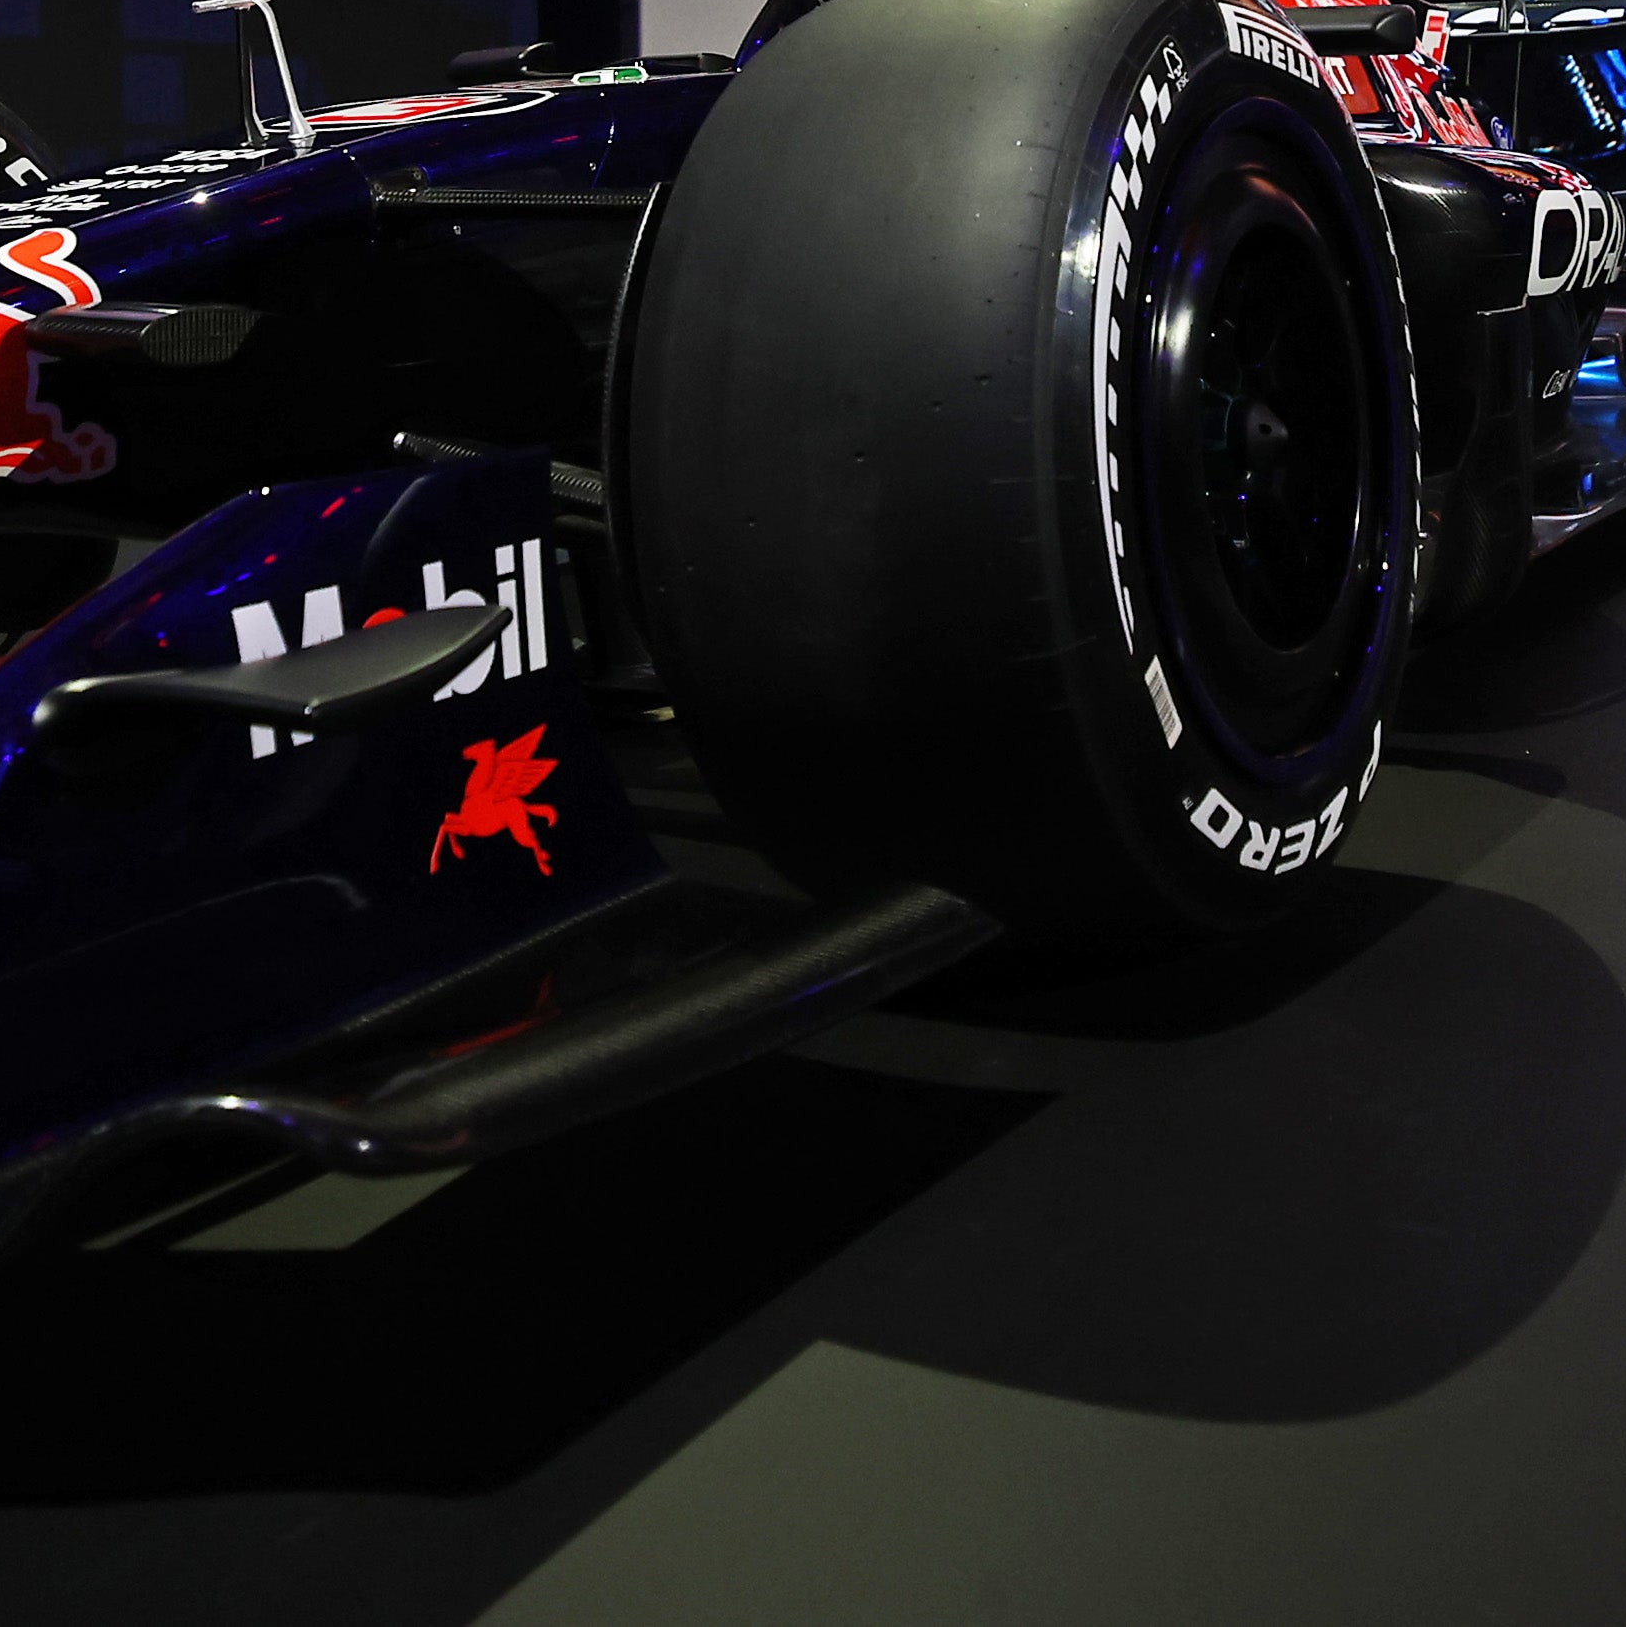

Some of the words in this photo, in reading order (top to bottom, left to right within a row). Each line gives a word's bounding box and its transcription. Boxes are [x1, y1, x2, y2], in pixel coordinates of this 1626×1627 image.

[1218, 2, 1320, 88] PIRELLI
[162, 148, 279, 162] VISA
[231, 538, 549, 760] Mbil
[1190, 786, 1349, 875] ZERO
